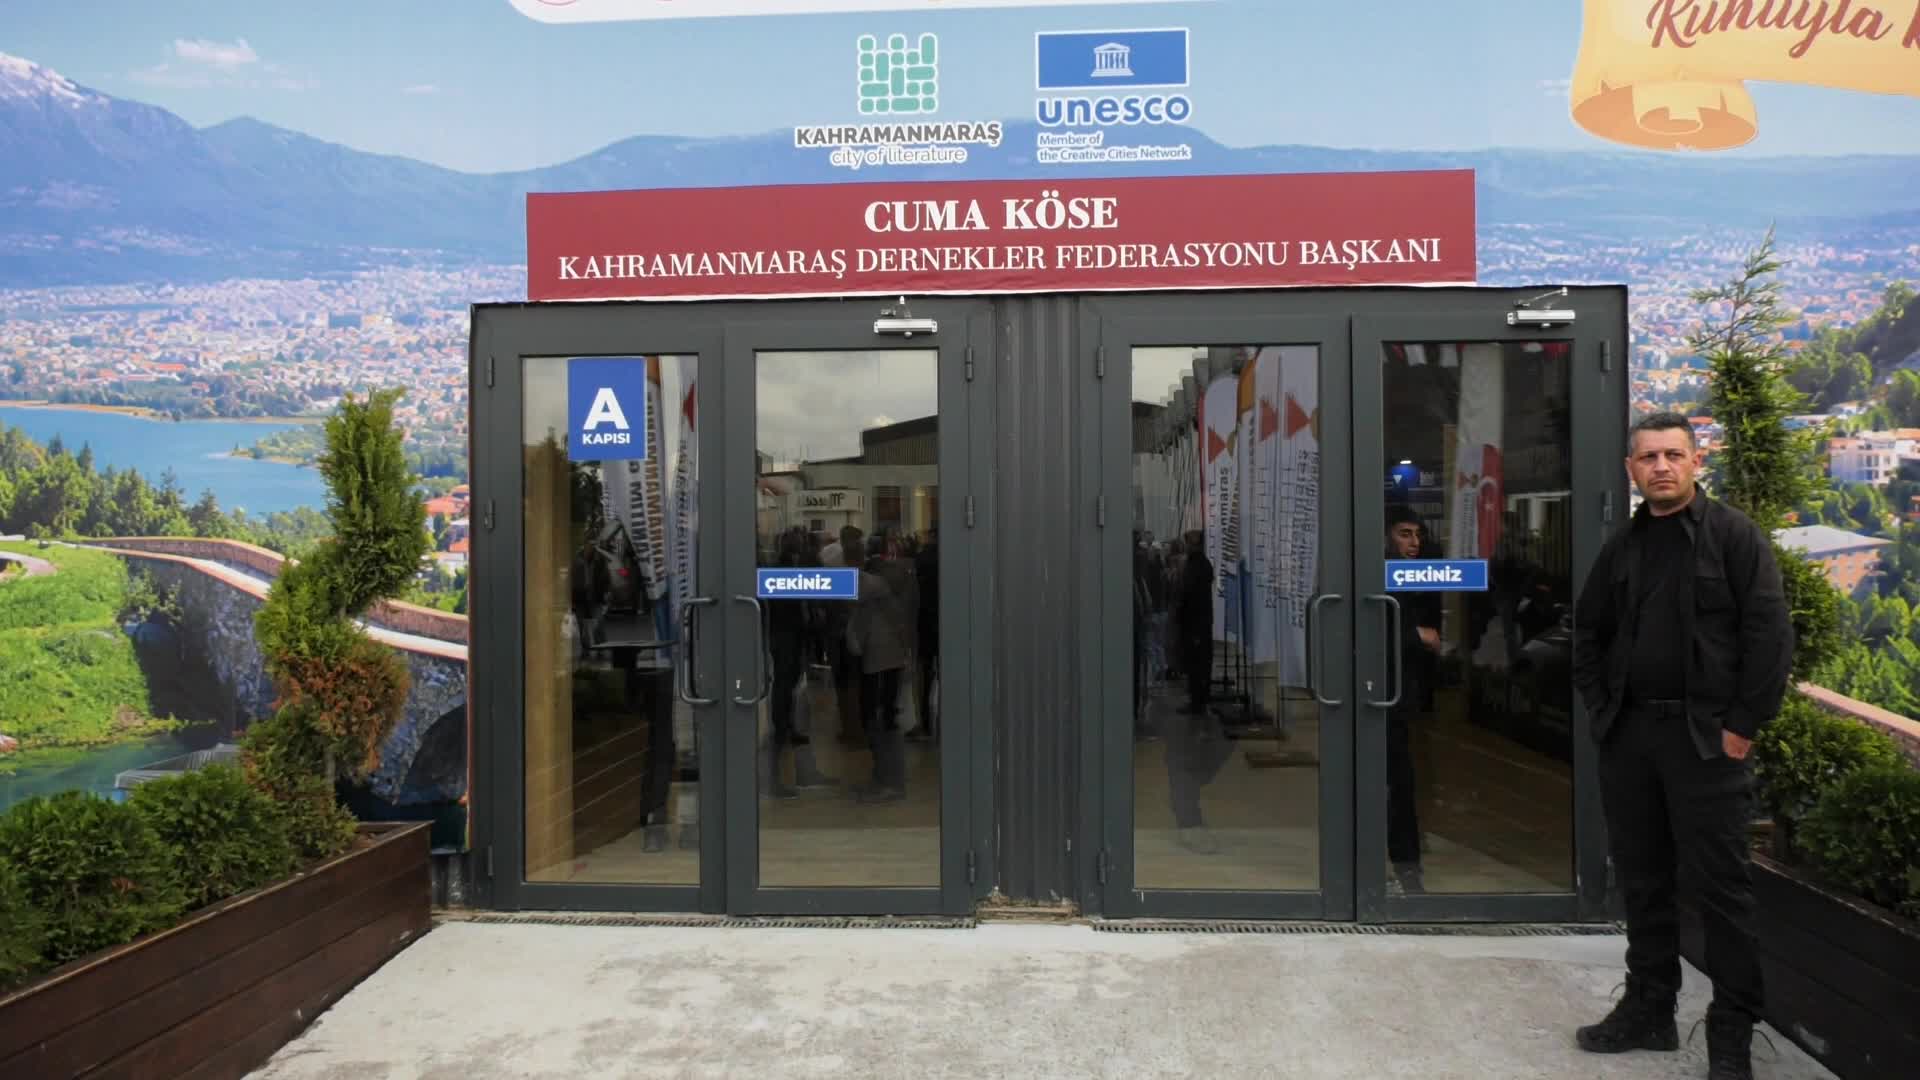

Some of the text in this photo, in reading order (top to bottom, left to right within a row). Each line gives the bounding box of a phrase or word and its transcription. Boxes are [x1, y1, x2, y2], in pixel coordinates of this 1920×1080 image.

[1038, 96, 1190, 124] unesco
[796, 123, 1001, 145] KAHRAMANMARAŞ
[1039, 133, 1102, 146] Member of
[832, 146, 966, 167] city of literature
[1039, 147, 1189, 161] the Creative Cities Network
[864, 190, 1119, 232] CUMA KÖSE
[558, 238, 1441, 279] KAHRAMANMARAŞ DERNEKLER FEDERASYONU BAŞKANI
[583, 387, 630, 430] A
[582, 433, 631, 445] KAPISI
[764, 573, 832, 594] ÇEKİNİZ
[1392, 565, 1462, 586] ÇEKİNİZ
